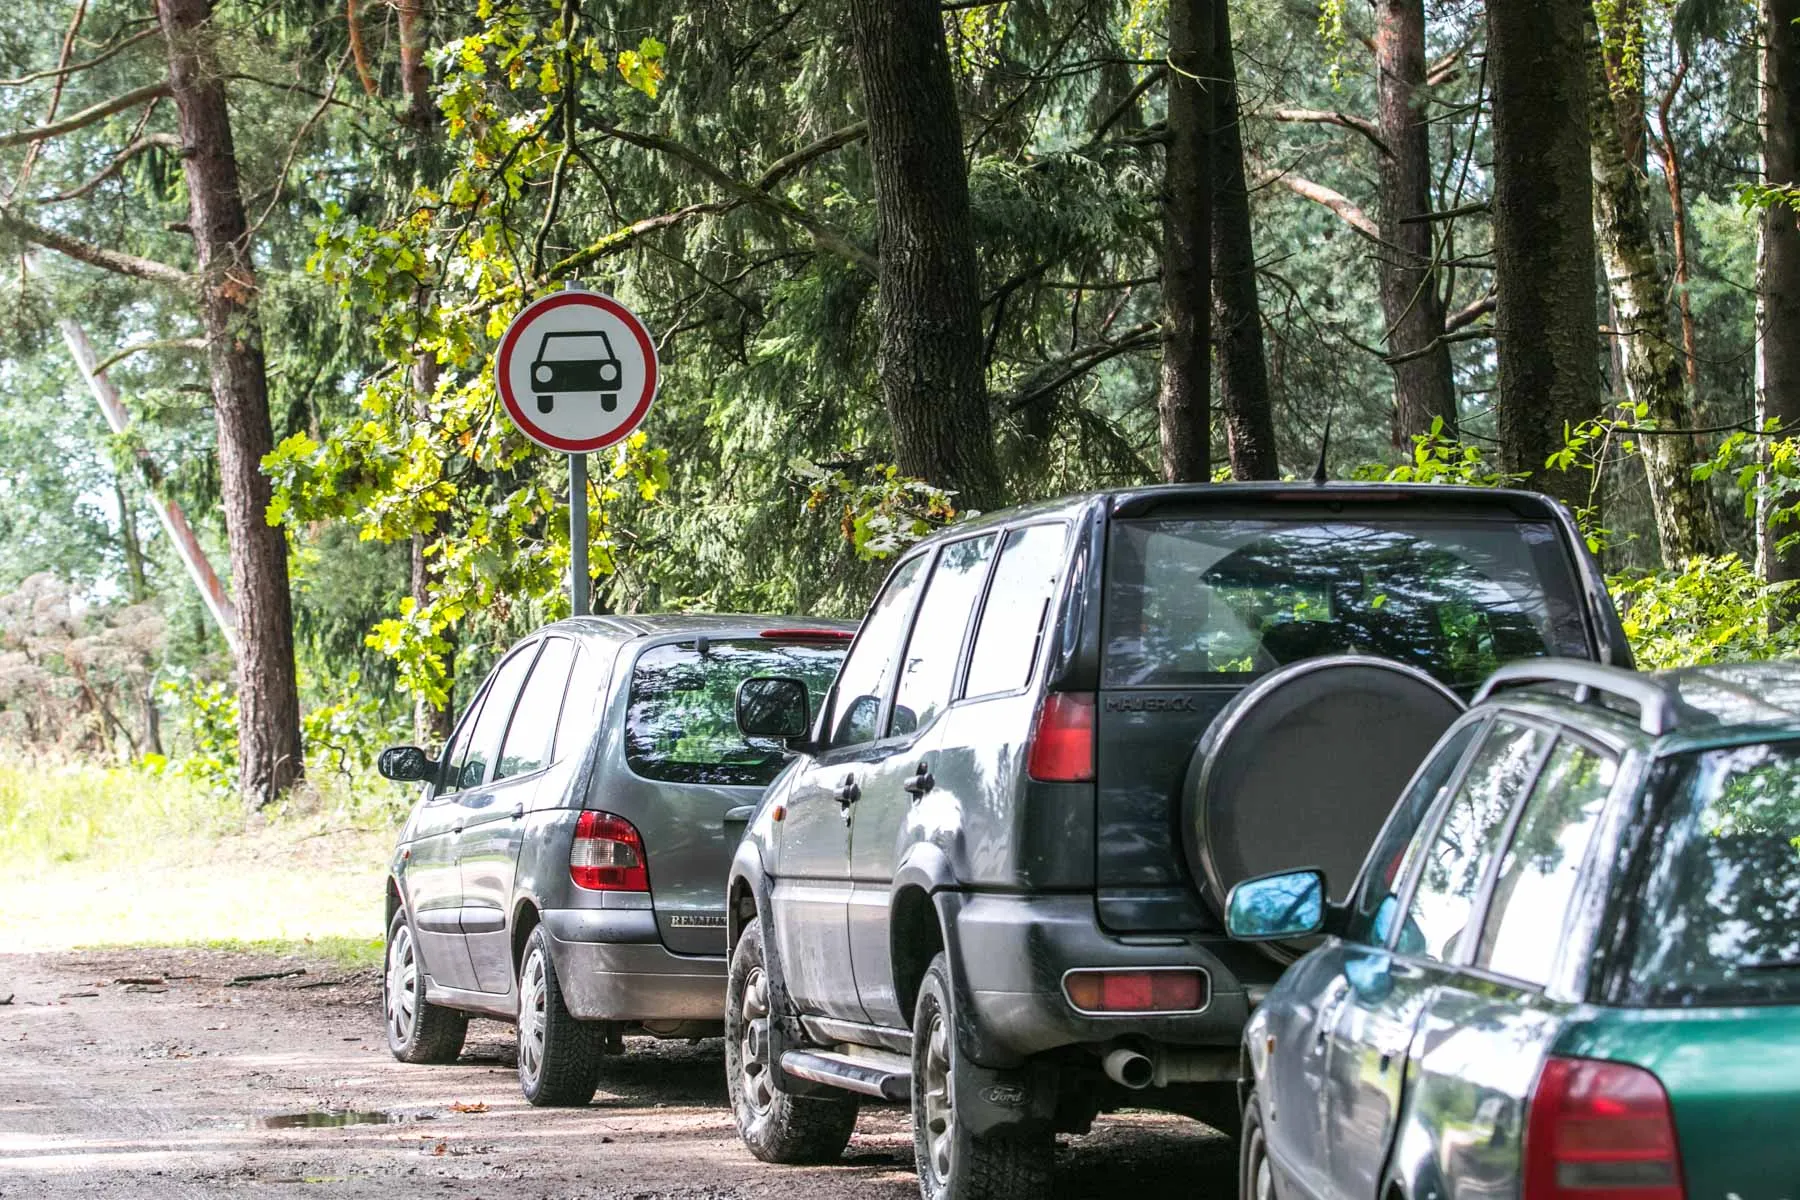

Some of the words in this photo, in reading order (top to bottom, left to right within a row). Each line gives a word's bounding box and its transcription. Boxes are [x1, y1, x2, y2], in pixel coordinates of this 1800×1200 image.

[1106, 696, 1198, 712] MAVERICK
[671, 915, 727, 927] RENAULT
[990, 1087, 1022, 1102] Ford
